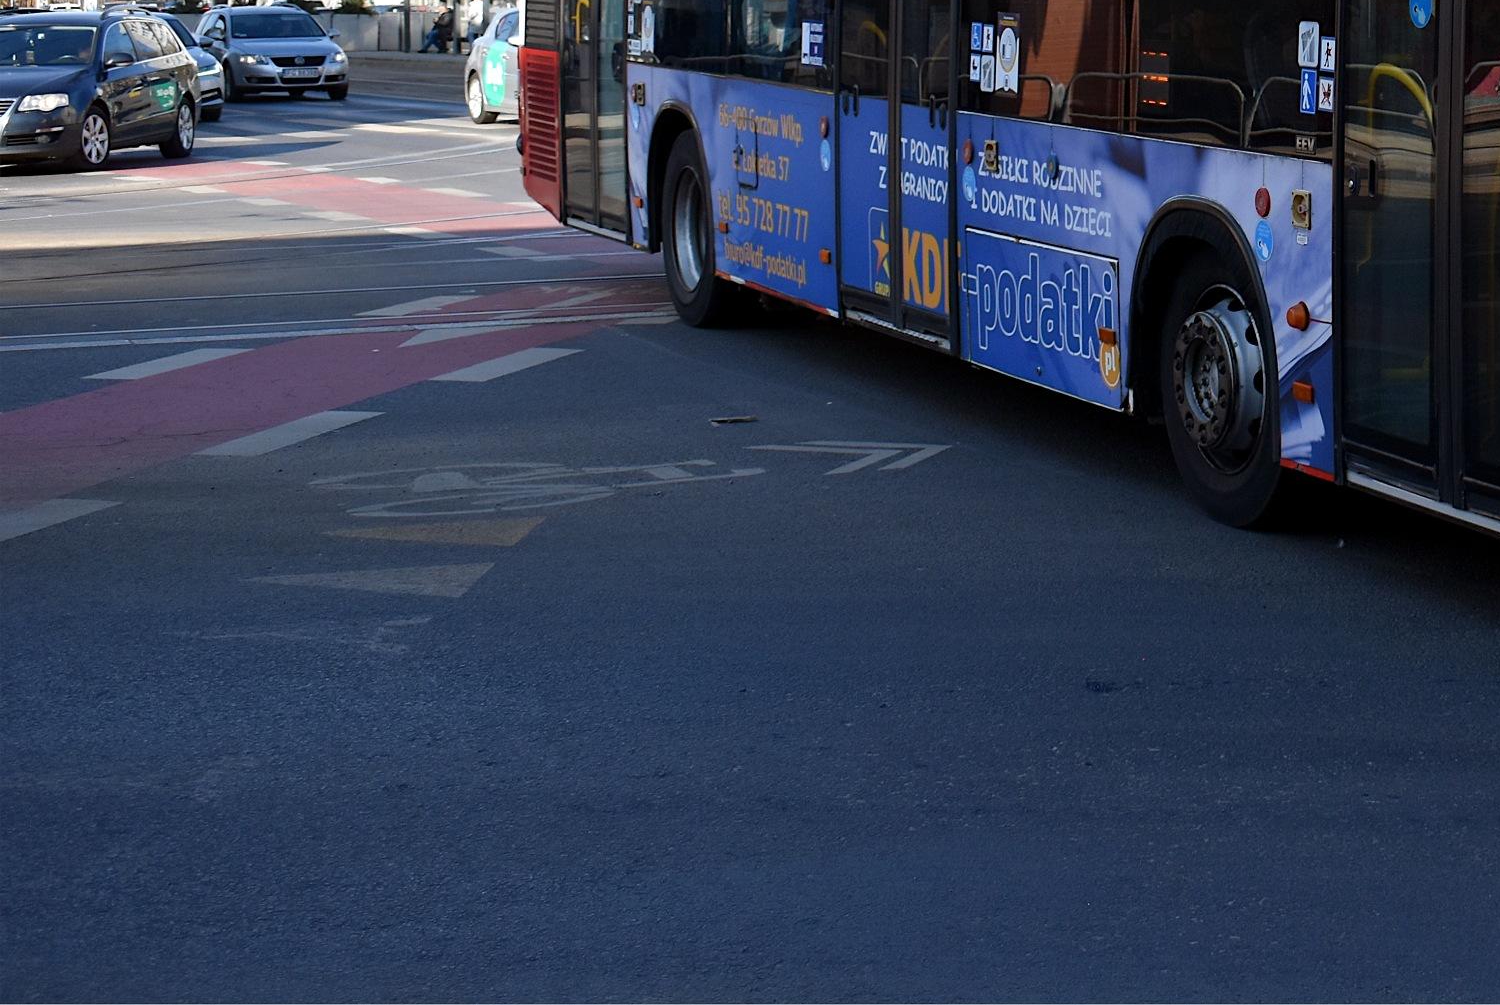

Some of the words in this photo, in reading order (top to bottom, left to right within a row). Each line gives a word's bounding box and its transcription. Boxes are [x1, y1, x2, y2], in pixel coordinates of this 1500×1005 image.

[720, 101, 747, 132] 66-400
[749, 108, 779, 137] Gorzów
[780, 113, 804, 148] Wlkp.
[1296, 135, 1316, 152] EEV
[778, 155, 789, 181] 37
[718, 188, 733, 222] tel.
[736, 194, 751, 227] 95
[752, 196, 774, 234] 728
[776, 203, 791, 238] 77
[794, 207, 809, 244] 77
[981, 187, 1037, 222] DODATKI
[1040, 199, 1060, 227] NA
[1064, 203, 1112, 238] DZIECI
[724, 236, 807, 290] biuro@kdf-podatki.pl
